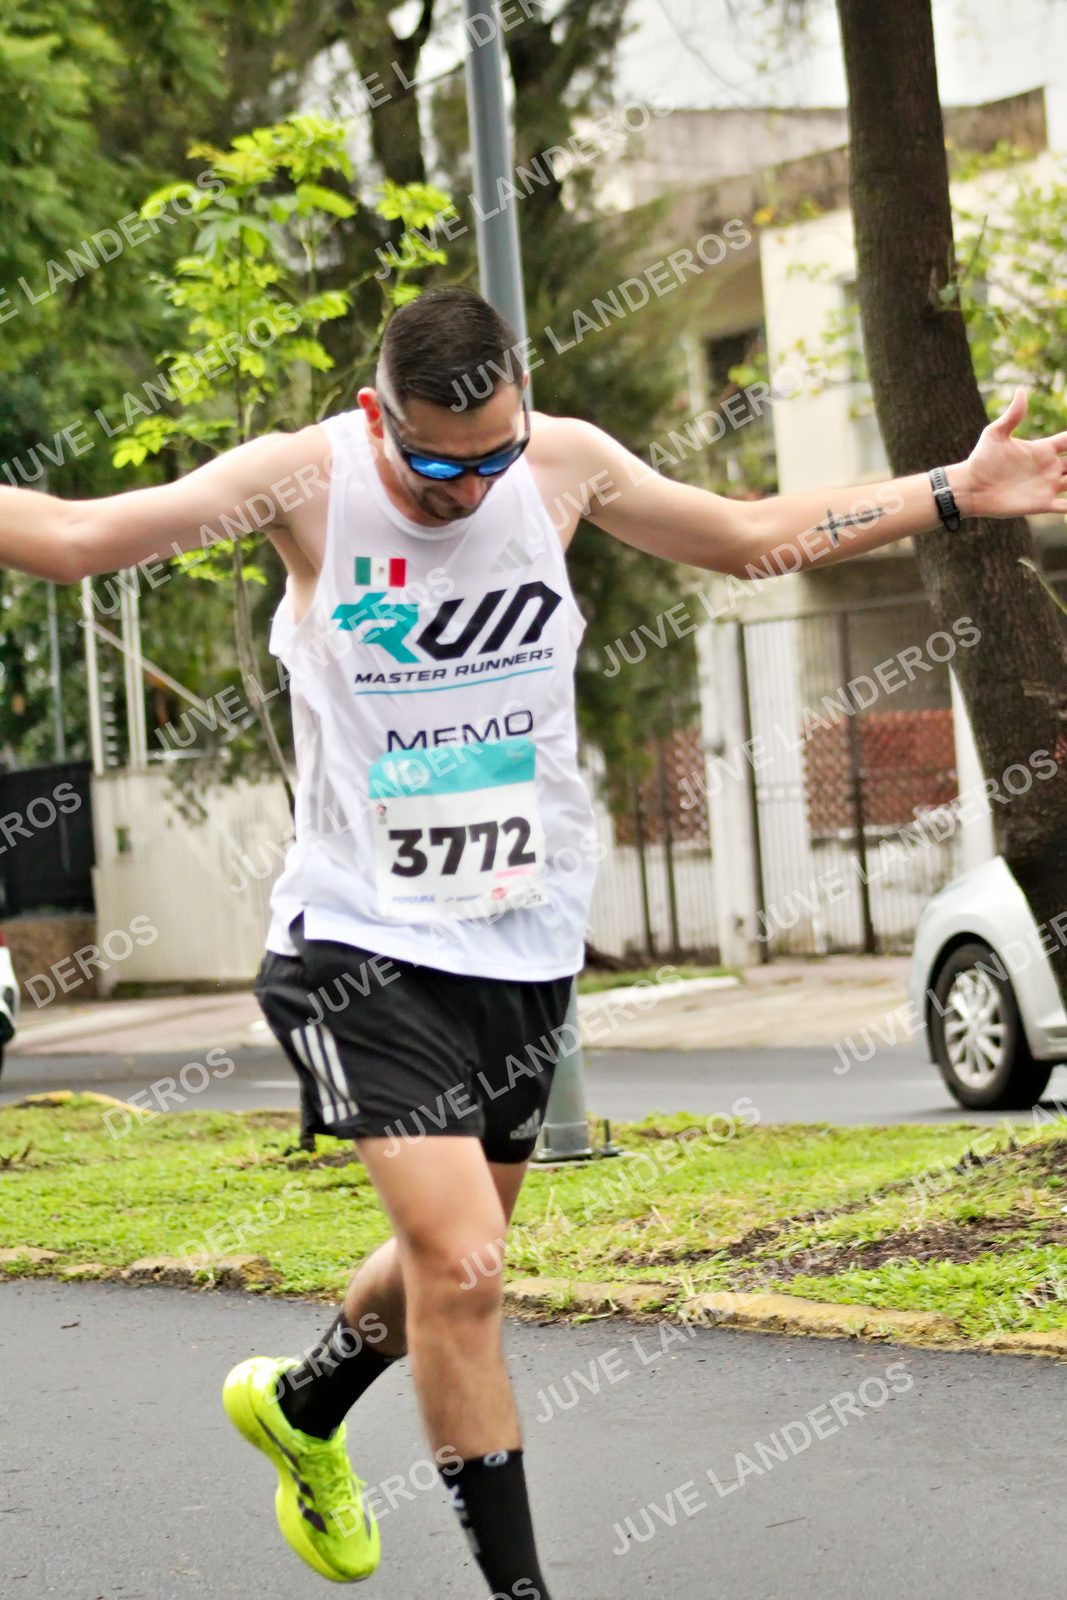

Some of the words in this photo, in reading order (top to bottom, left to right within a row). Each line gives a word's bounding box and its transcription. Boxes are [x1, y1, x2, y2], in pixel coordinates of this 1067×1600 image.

[354, 668, 447, 684] MASTER
[454, 647, 555, 677] RUNNERS
[388, 816, 537, 878] 3772
